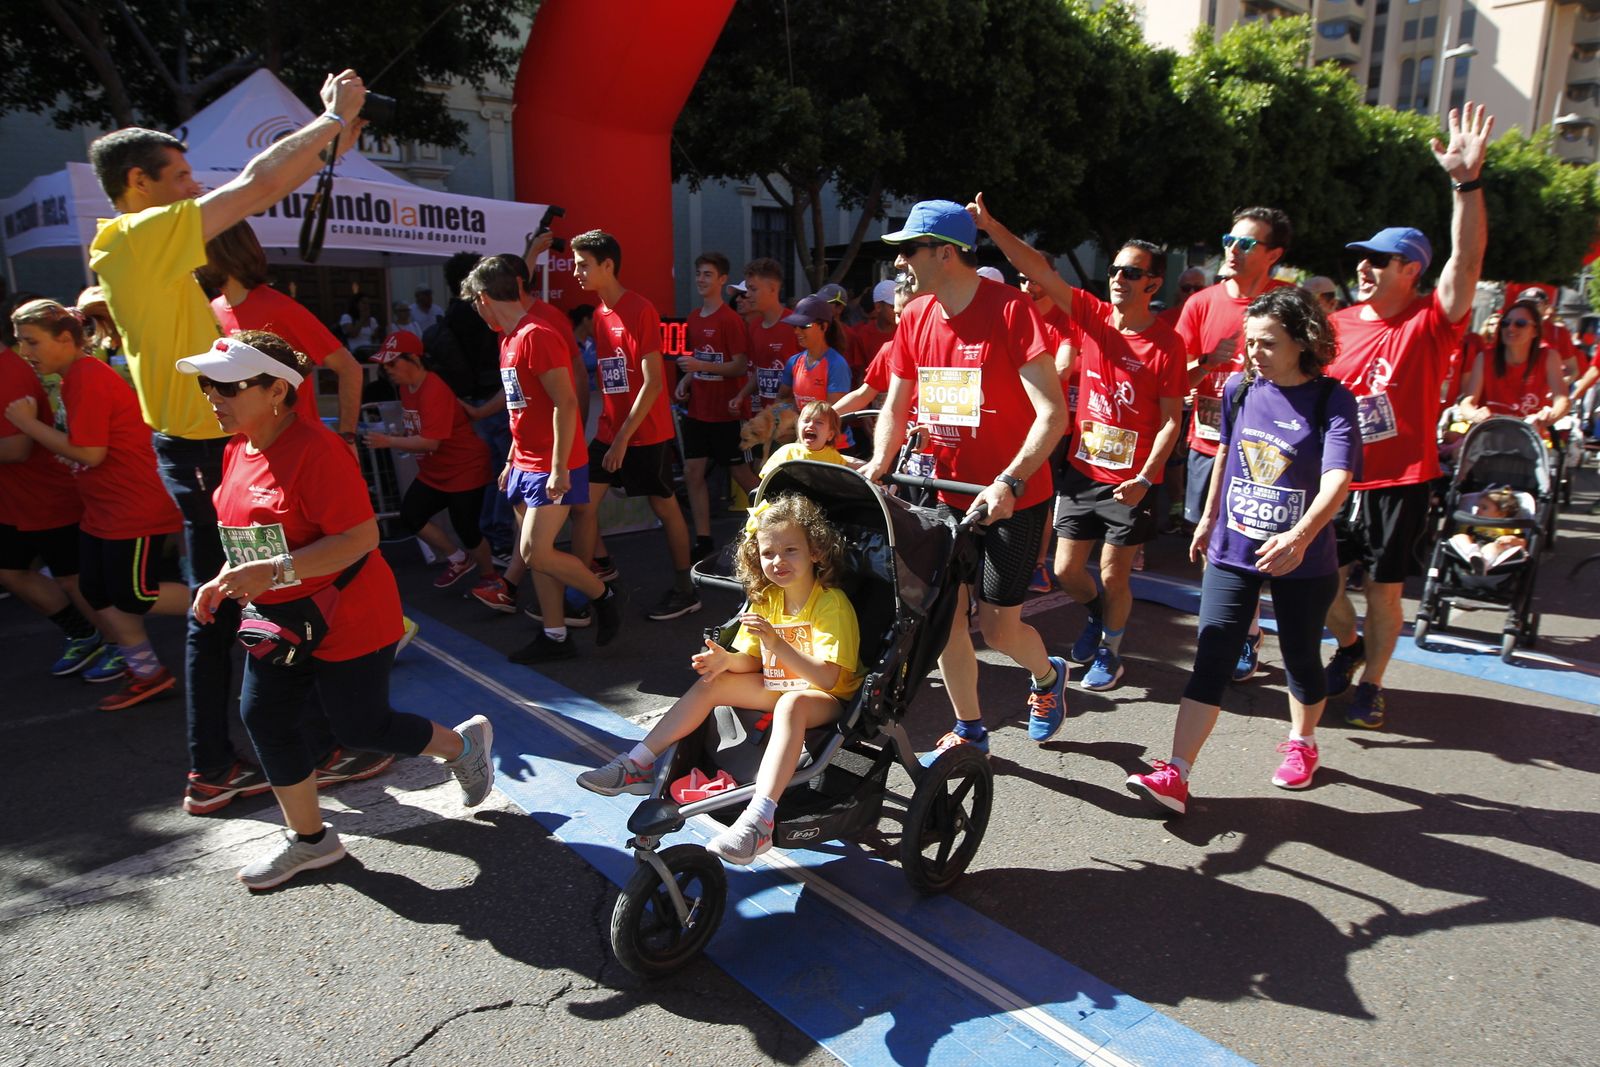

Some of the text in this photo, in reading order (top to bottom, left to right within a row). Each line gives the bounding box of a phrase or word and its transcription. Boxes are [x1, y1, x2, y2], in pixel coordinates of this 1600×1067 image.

[330, 223, 487, 246] cronometraje deportivo
[925, 386, 970, 404] 3060
[1264, 432, 1275, 443] DE
[1232, 495, 1288, 523] 2260
[226, 545, 272, 565] 303
